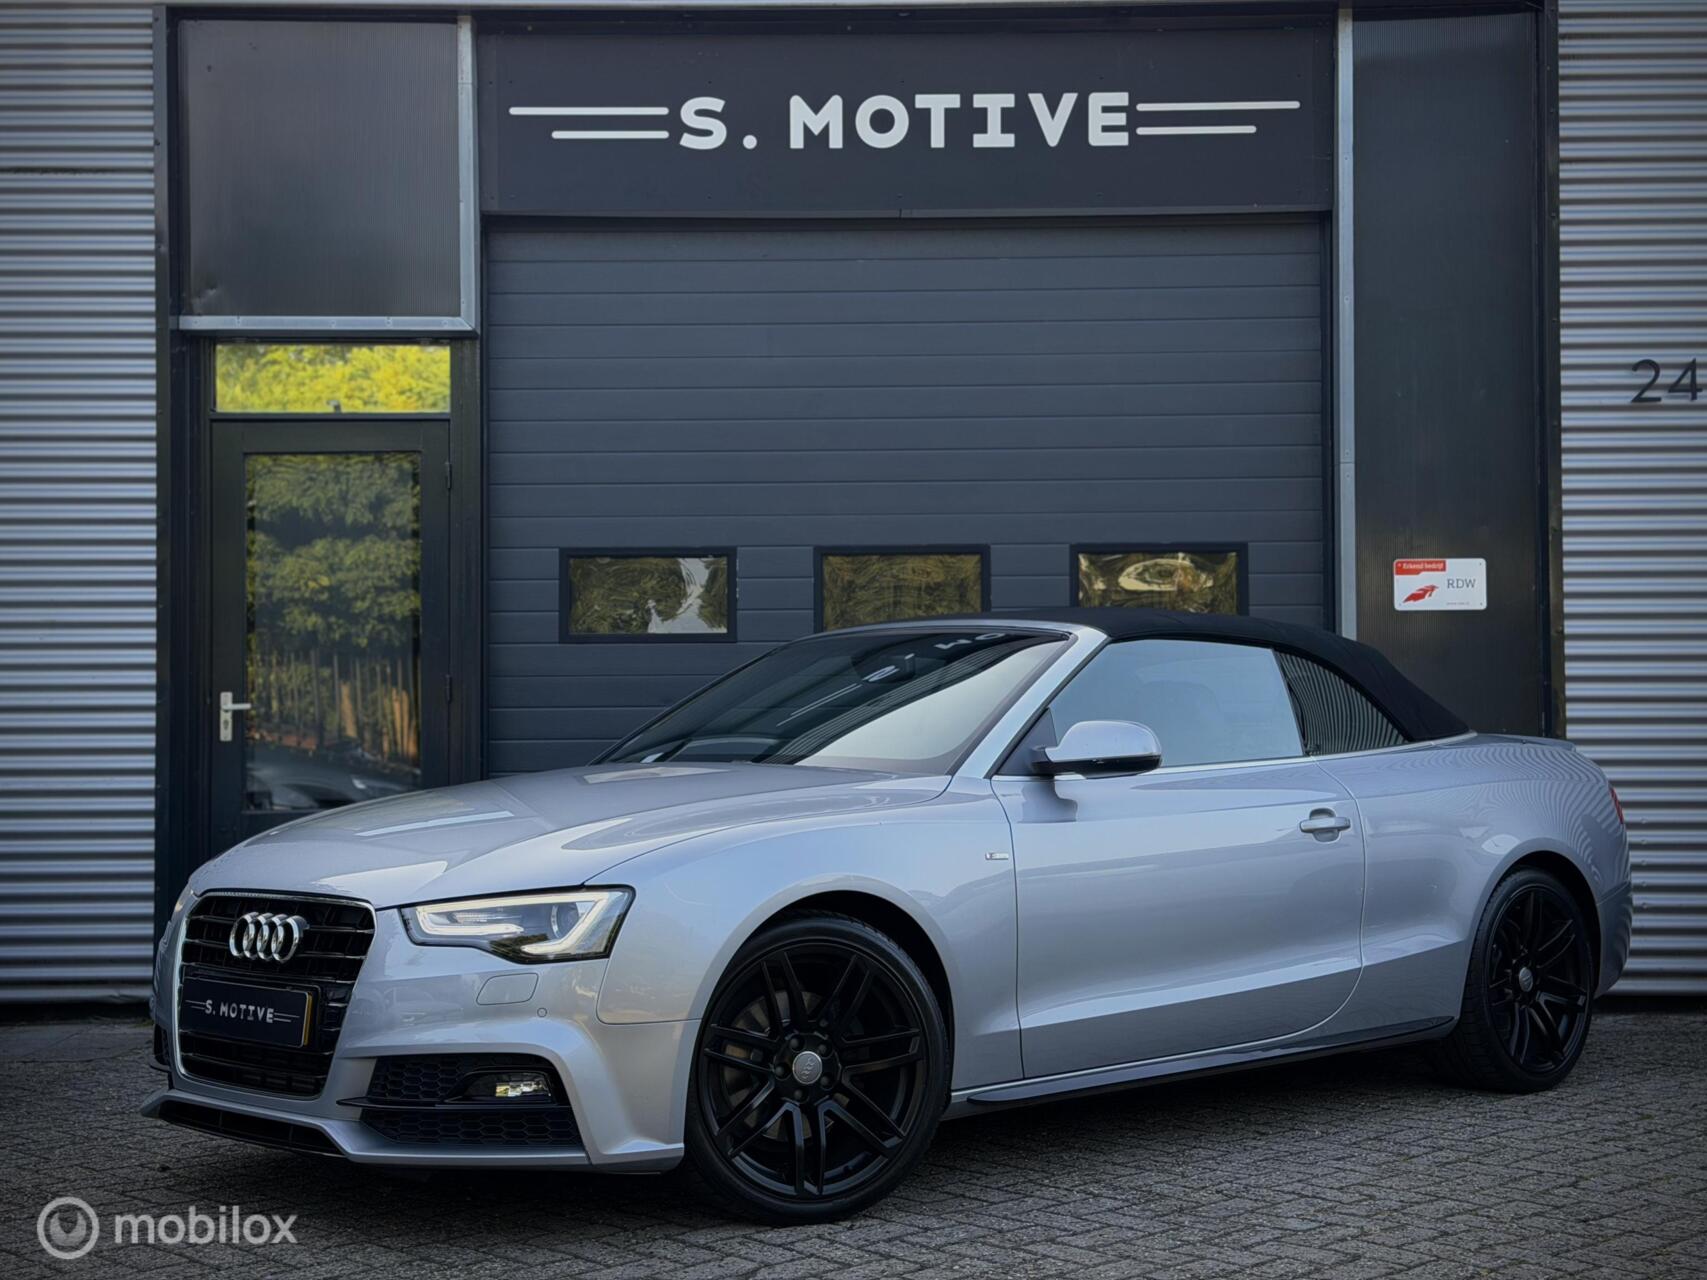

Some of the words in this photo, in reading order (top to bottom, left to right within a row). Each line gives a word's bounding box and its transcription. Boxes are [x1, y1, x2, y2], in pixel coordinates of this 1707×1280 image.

[679, 96, 758, 150] S.
[789, 91, 1130, 149] MOTIVE
[1630, 357, 1703, 403] 24
[1447, 578, 1476, 589] RDW
[204, 999, 216, 1015] S.
[219, 1002, 275, 1023] MOTIVE
